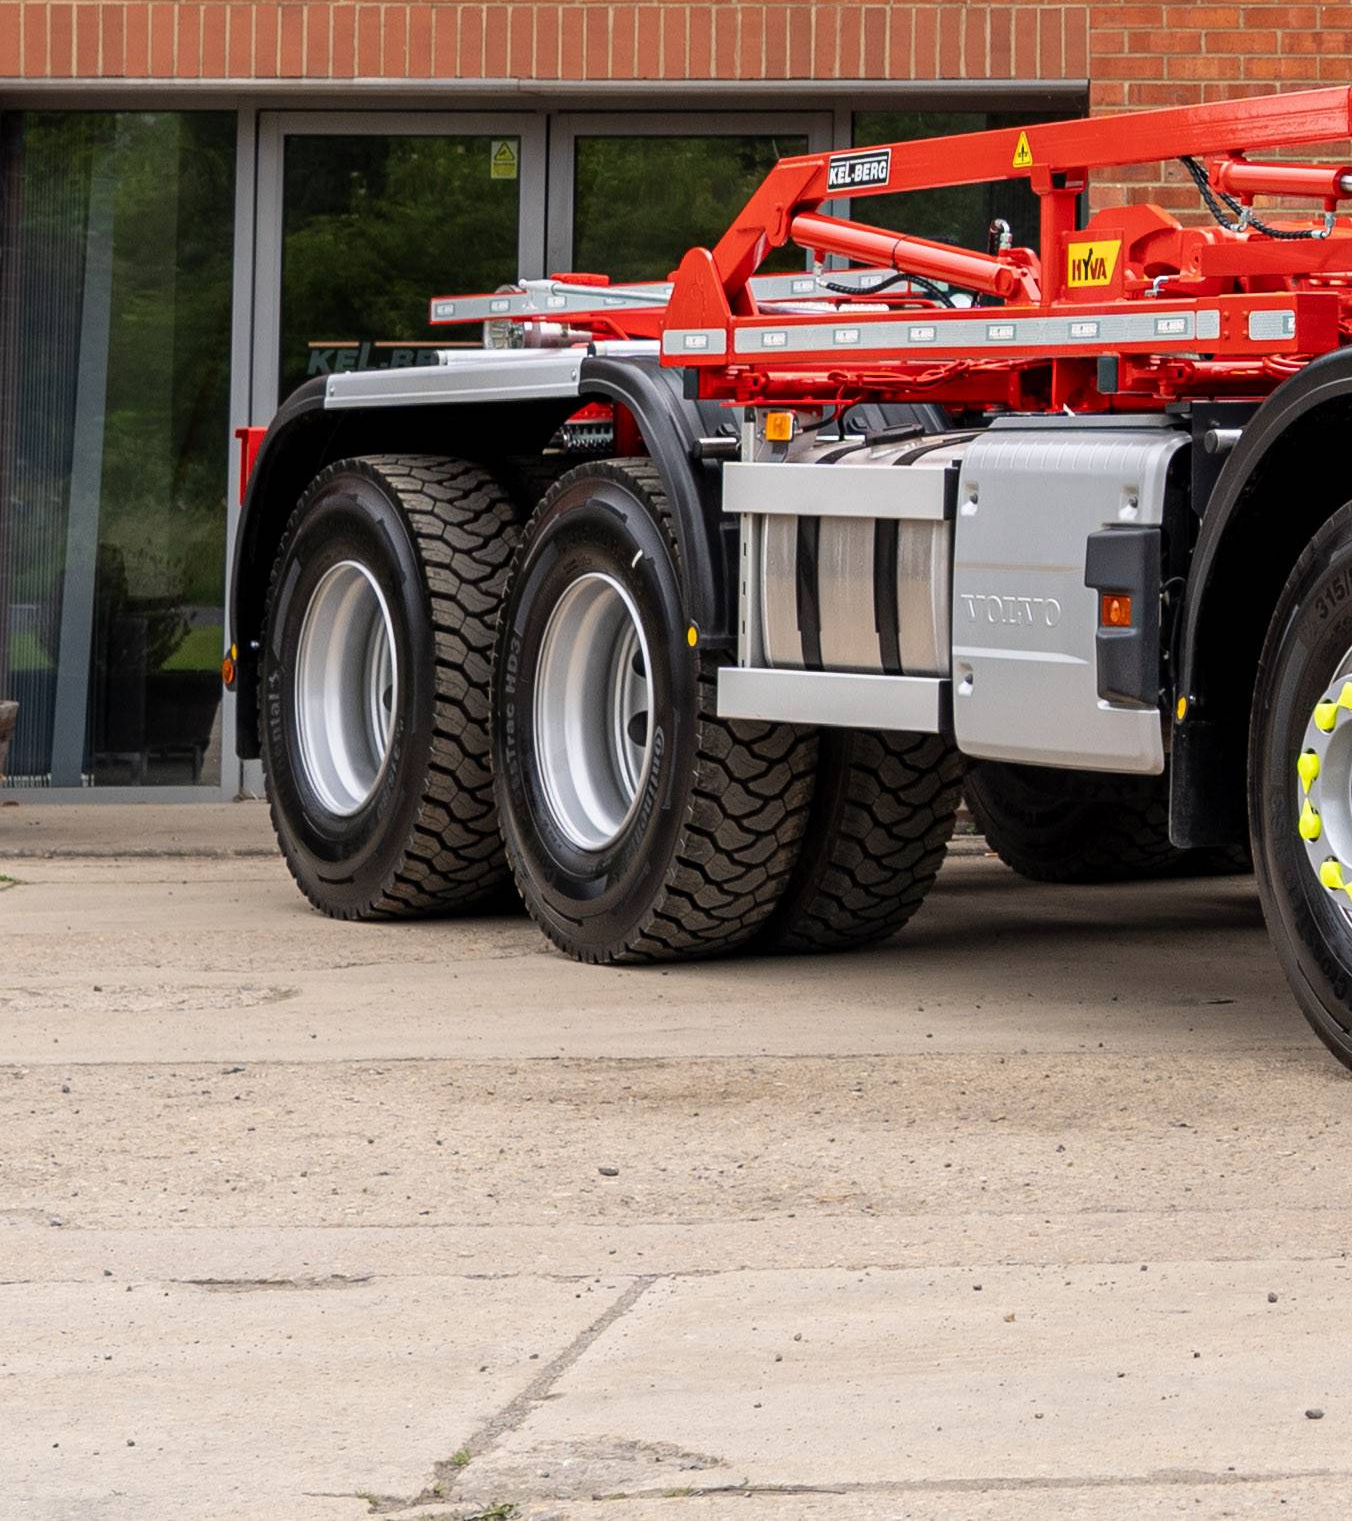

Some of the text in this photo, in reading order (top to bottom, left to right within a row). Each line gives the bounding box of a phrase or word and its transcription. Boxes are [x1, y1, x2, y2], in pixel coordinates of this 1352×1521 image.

[829, 160, 887, 185] KEL-BERG
[1072, 248, 1107, 281] HYVA
[961, 594, 1061, 627] VOLVO
[504, 636, 521, 694] HD3
